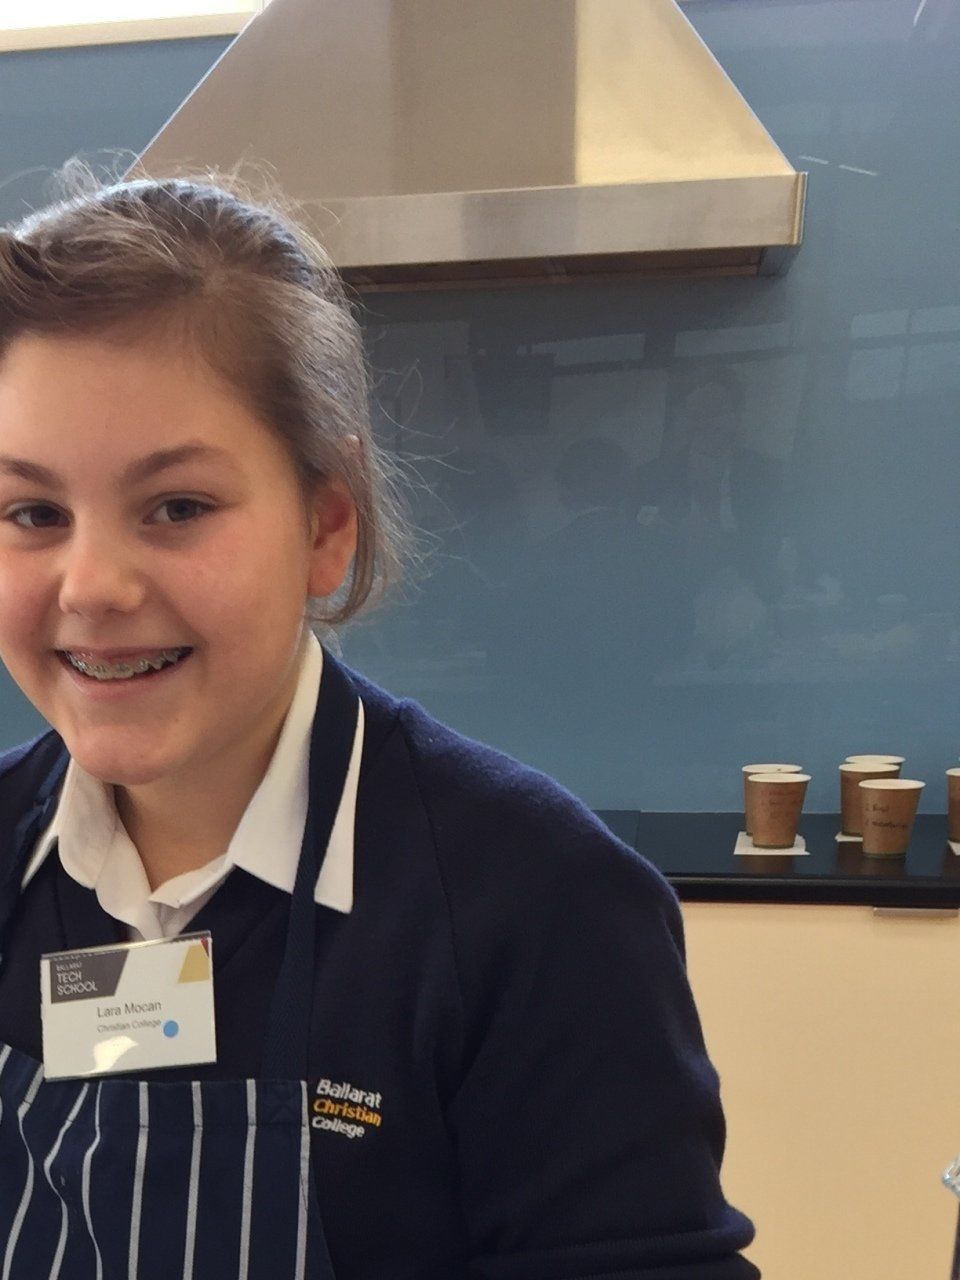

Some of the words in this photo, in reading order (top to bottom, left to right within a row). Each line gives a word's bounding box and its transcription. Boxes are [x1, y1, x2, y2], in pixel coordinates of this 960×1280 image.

[57, 971, 82, 983] TECH
[57, 980, 99, 996] SCHOOL
[97, 1006, 122, 1019] Lara
[315, 1078, 382, 1109] Ballarat
[312, 1098, 382, 1127] Christian
[311, 1116, 366, 1139] College
